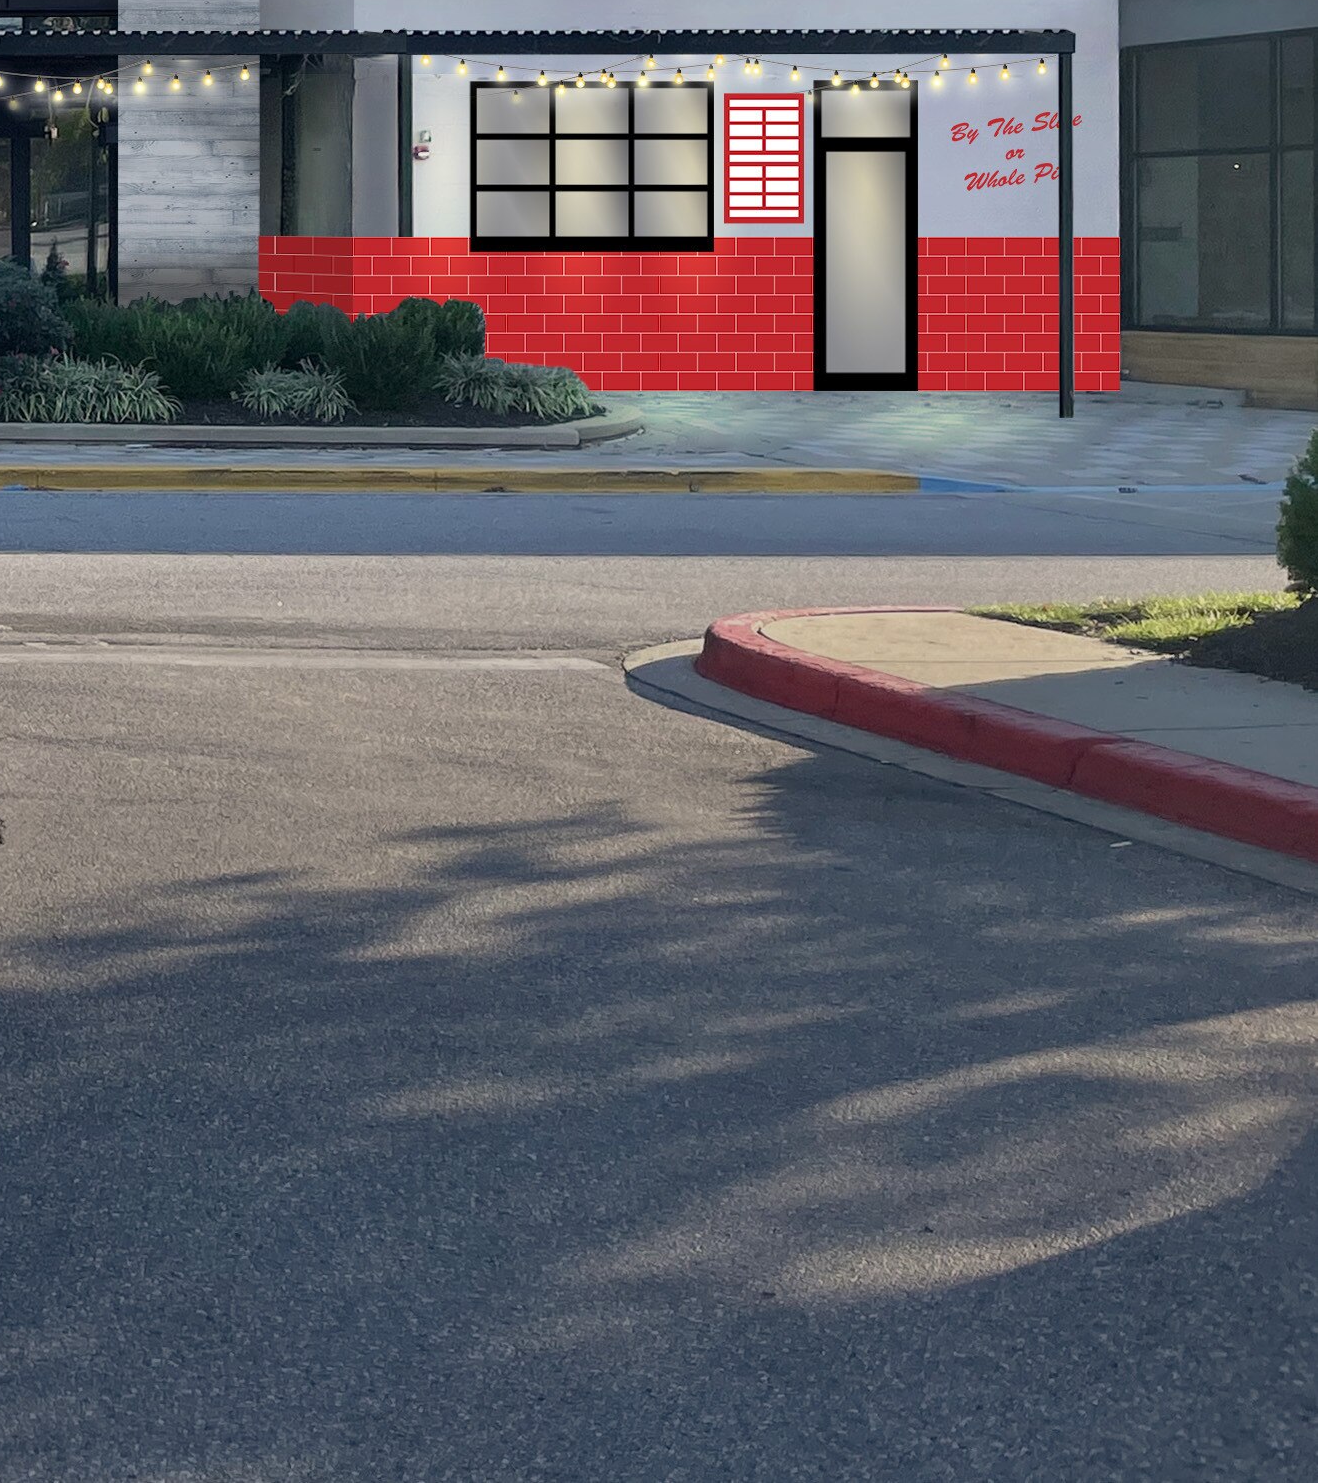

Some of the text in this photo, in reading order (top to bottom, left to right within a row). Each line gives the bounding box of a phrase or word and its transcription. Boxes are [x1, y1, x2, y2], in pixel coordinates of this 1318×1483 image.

[950, 122, 980, 145] By
[987, 117, 1024, 138] The
[1005, 148, 1026, 160] or
[964, 162, 1060, 192] Whole Pi
